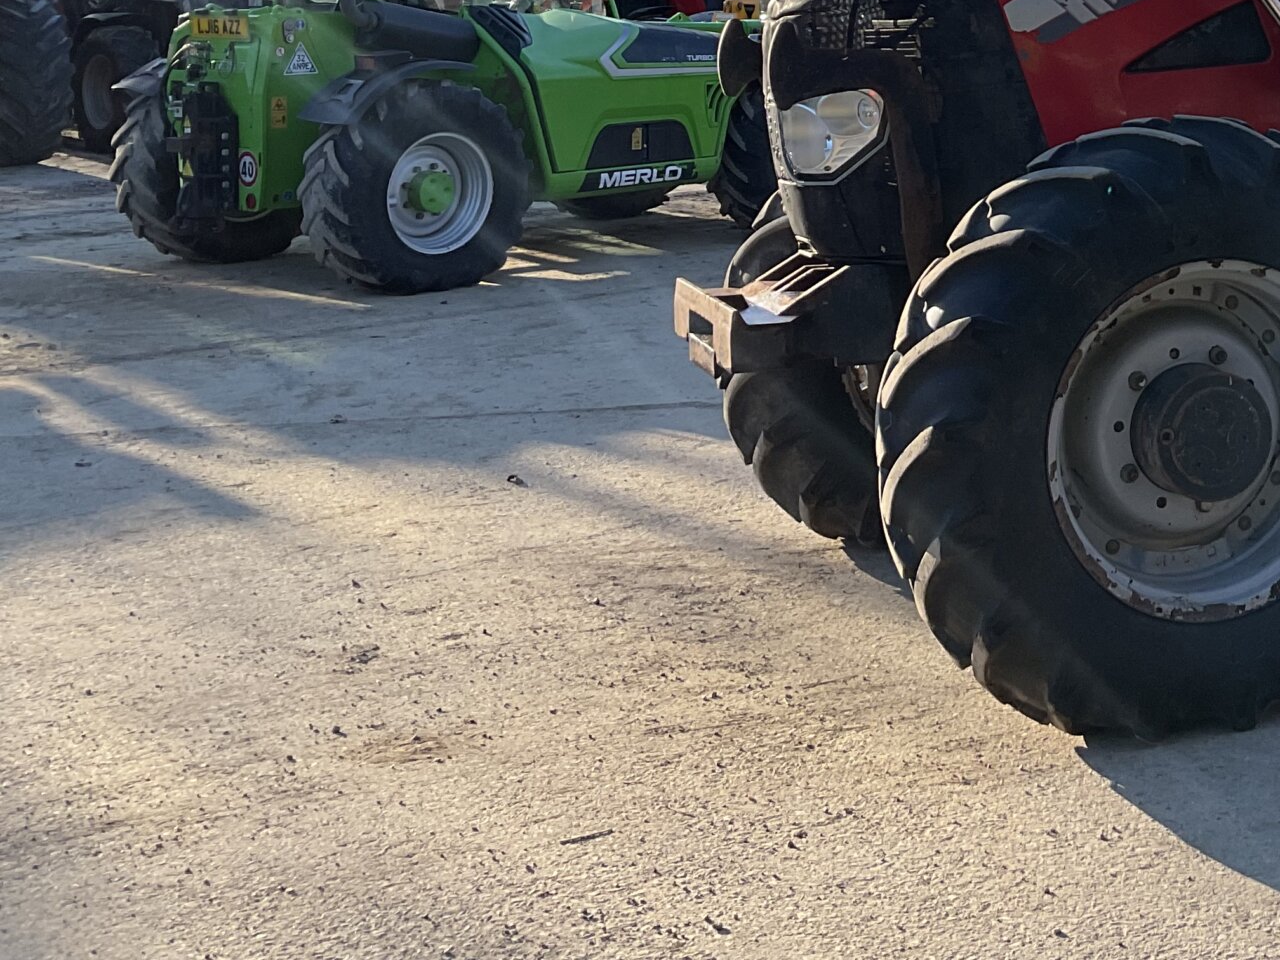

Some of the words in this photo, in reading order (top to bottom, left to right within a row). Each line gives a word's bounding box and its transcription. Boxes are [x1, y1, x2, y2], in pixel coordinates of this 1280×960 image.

[197, 19, 220, 35] LJ16
[222, 19, 241, 35] AZZ
[296, 54, 306, 63] 32
[241, 160, 254, 178] 40
[598, 165, 683, 189] MERLO
